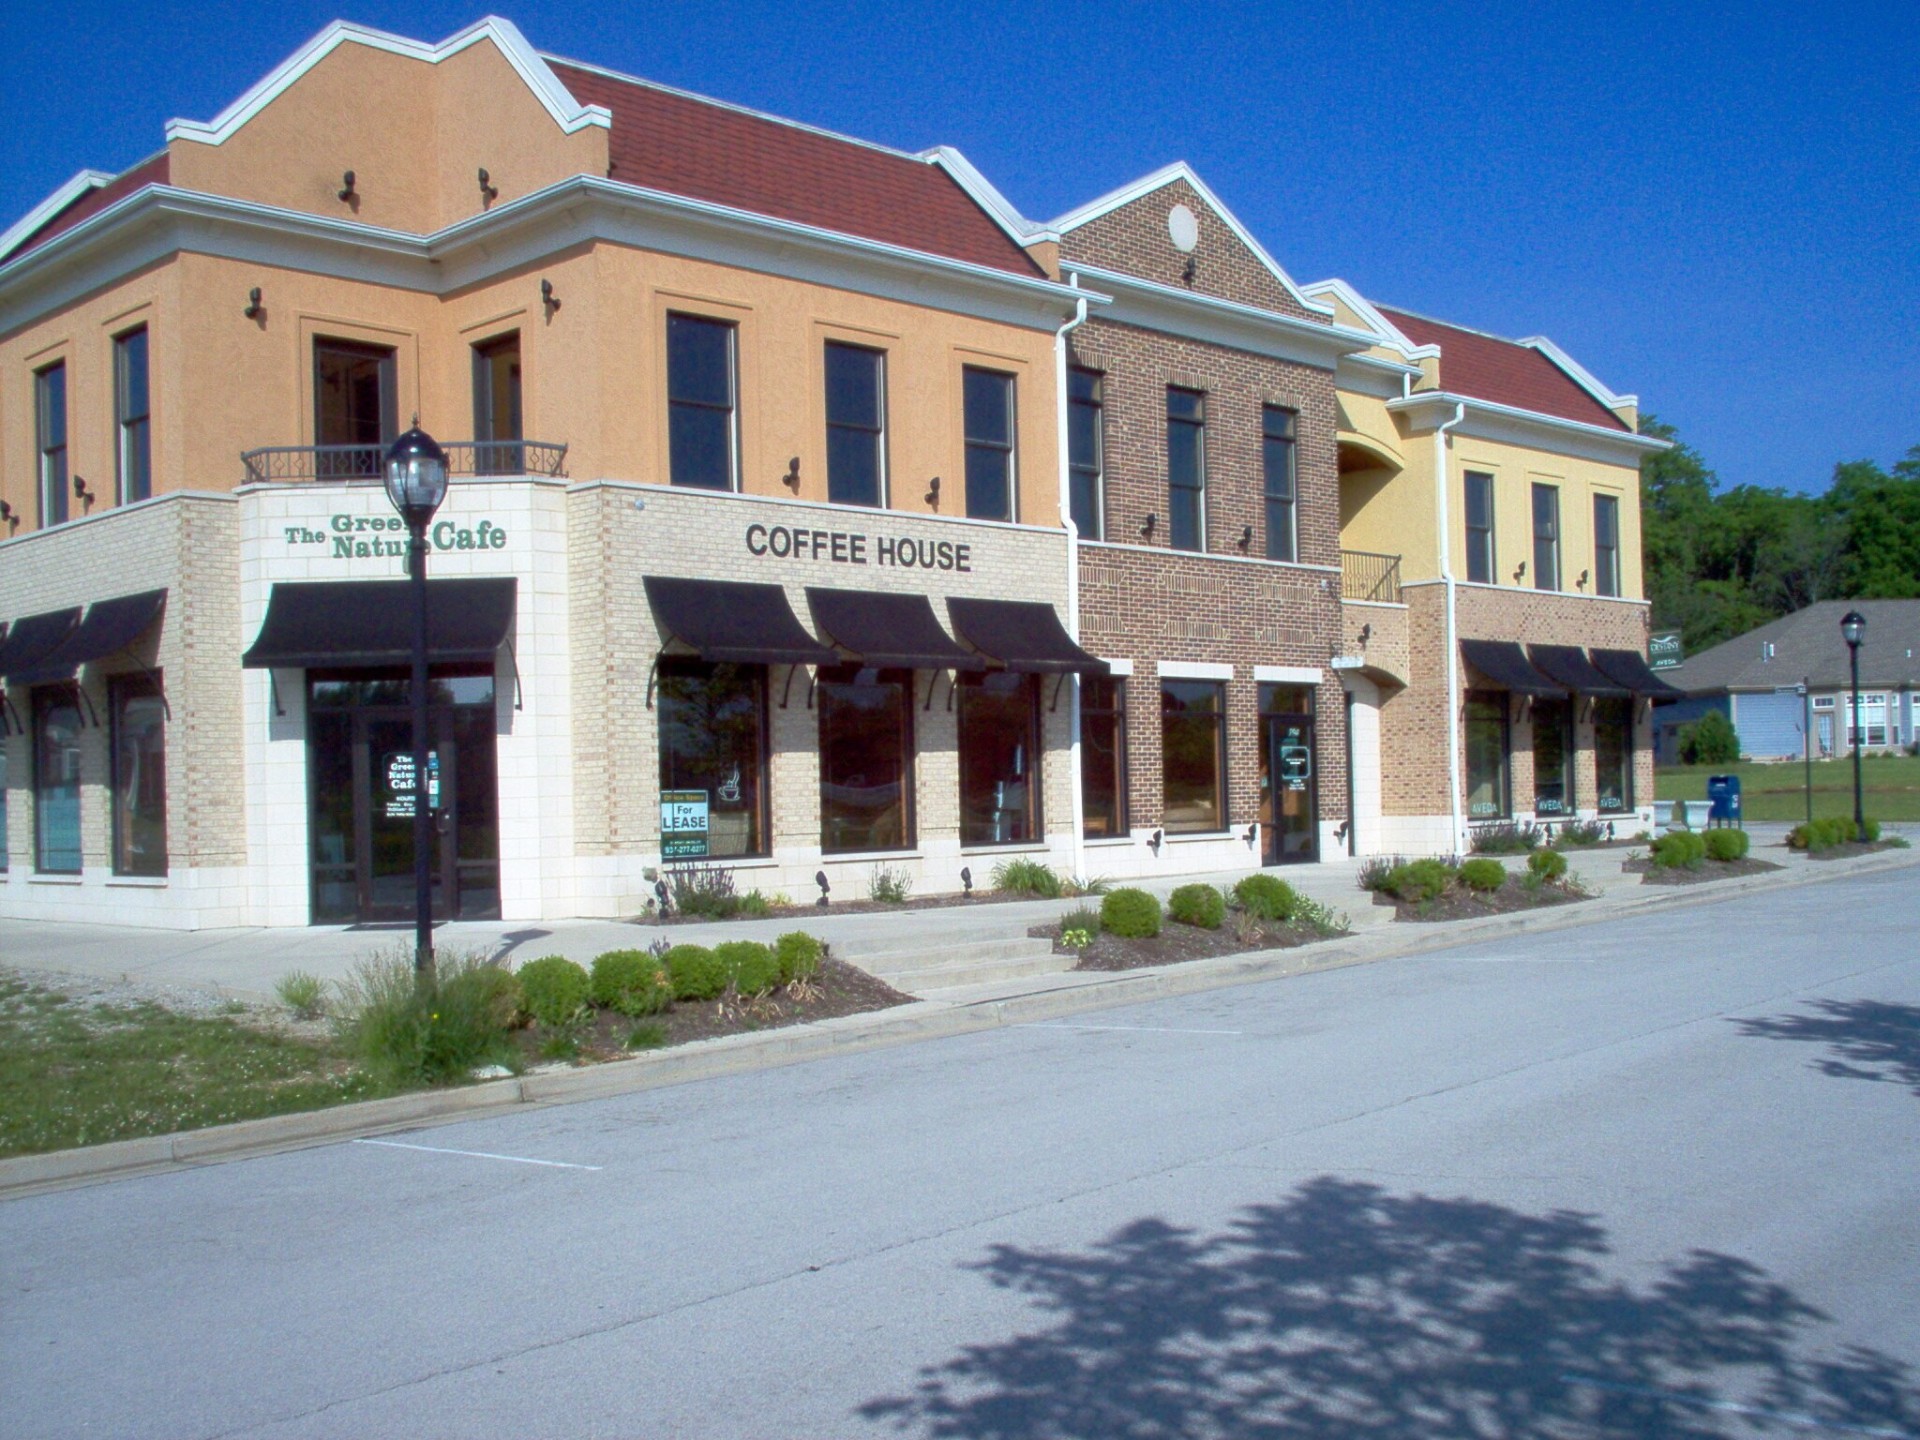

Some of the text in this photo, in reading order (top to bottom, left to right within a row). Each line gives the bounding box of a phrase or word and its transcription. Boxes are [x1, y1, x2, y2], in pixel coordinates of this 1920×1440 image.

[331, 514, 410, 532] Gree
[285, 527, 326, 544] The
[433, 520, 507, 550] Cafe
[746, 523, 971, 572] COFFEE HOUSE
[1472, 802, 1497, 813] AVEDA
[1538, 800, 1562, 811] AVEDA
[1600, 798, 1621, 807] AVEDA
[677, 805, 693, 814] For
[663, 816, 706, 829] LEASE
